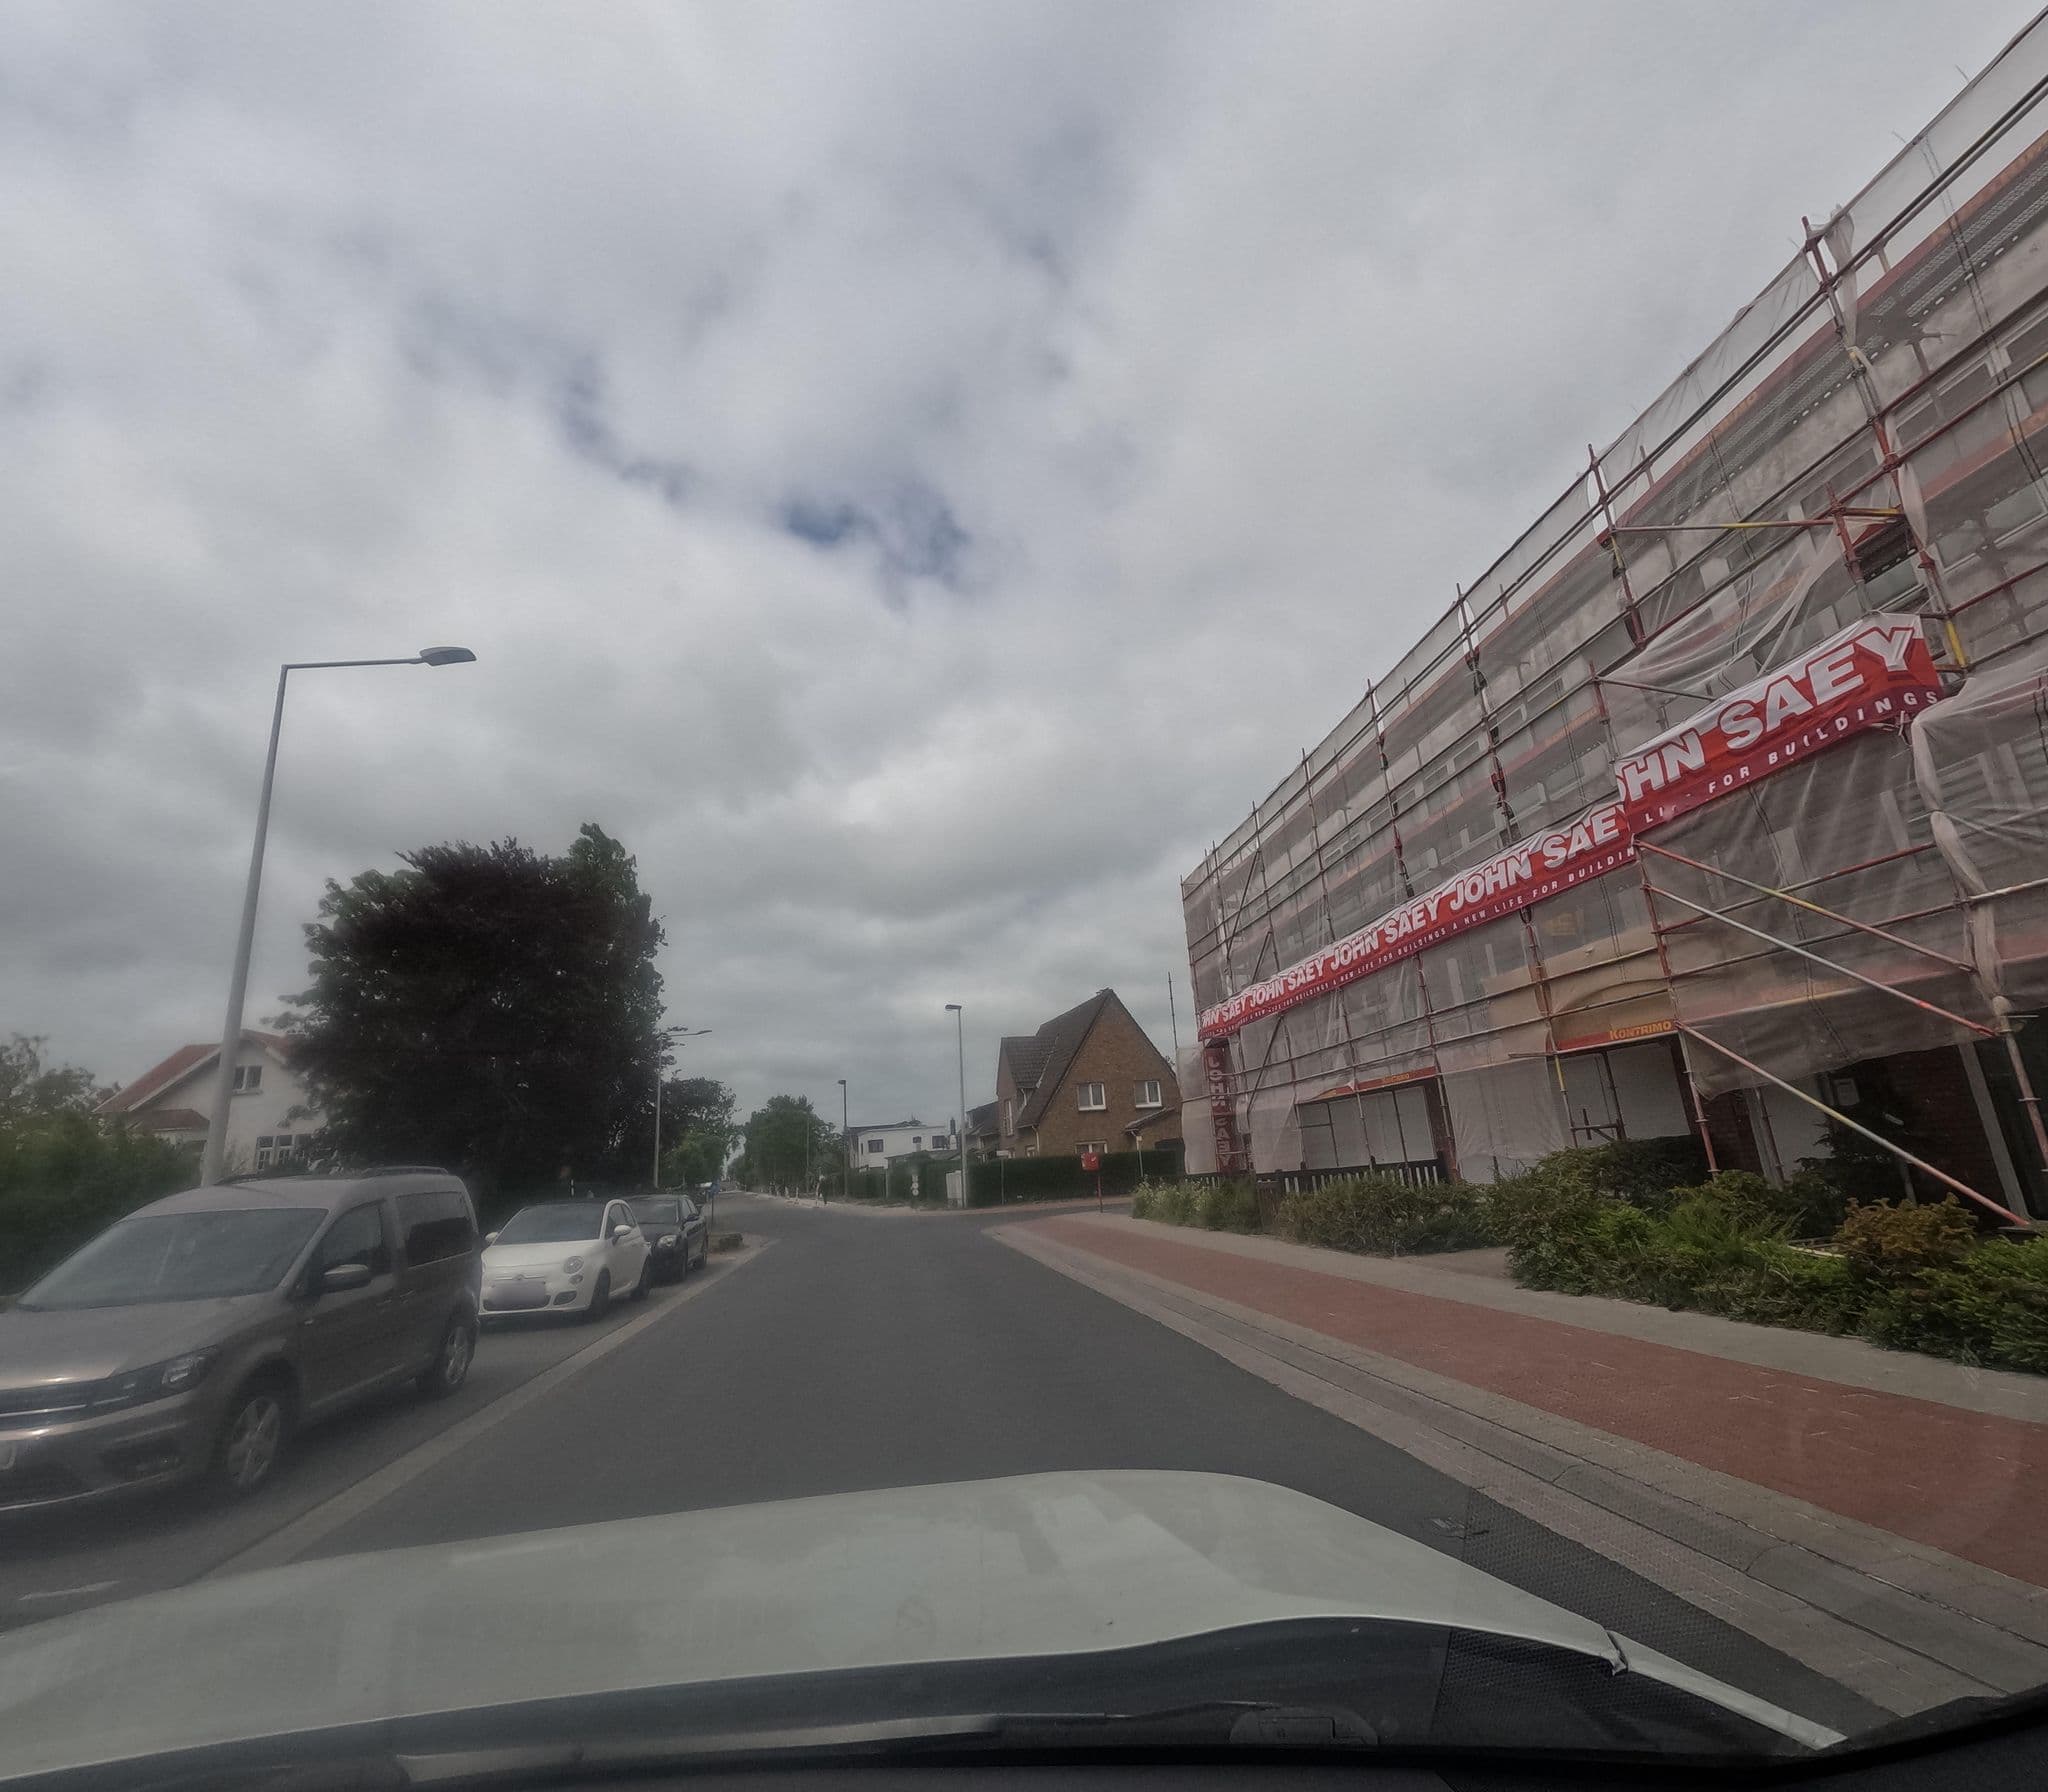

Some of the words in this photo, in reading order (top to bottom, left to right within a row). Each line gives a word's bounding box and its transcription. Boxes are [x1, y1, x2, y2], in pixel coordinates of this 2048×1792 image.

[1708, 766, 1750, 794] FOR
[1768, 690, 1939, 765] BUILDINGS
[1719, 629, 1914, 750] SAEY
[1222, 996, 1247, 1022] SAEY
[1250, 979, 1285, 1007] JOHN
[1288, 955, 1326, 991] SAEY
[1330, 929, 1380, 970] JOHN
[1384, 891, 1442, 944] SAEY
[1449, 850, 1533, 911] JOHN
[1542, 804, 1626, 869] SAE
[1378, 952, 1393, 963] FOR
[1398, 928, 1446, 955] BUILDINGS
[1452, 922, 1458, 930] A
[1464, 910, 1486, 924] NEW
[1494, 896, 1523, 913] LIFE
[1532, 880, 1558, 898] FOR
